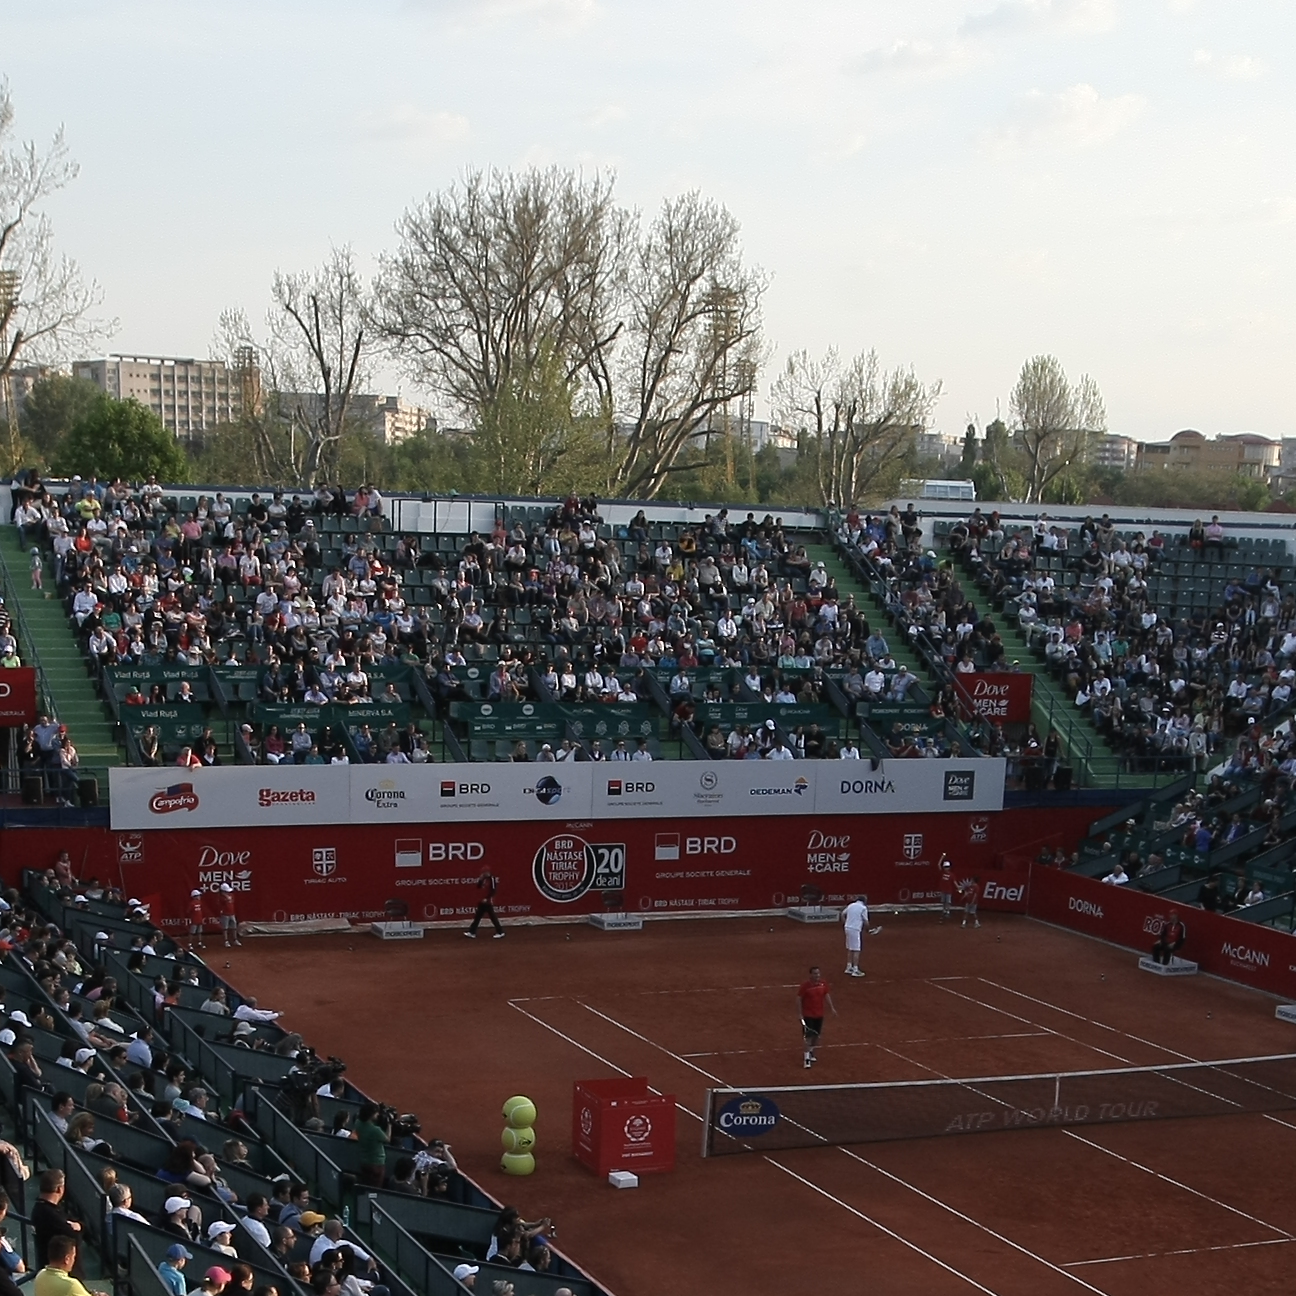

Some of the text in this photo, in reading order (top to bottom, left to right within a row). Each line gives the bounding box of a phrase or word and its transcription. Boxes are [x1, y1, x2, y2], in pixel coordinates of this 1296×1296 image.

[973, 679, 1009, 696] Dove
[973, 698, 997, 708] MEN
[459, 783, 490, 794] BRD
[625, 782, 655, 793] BRD
[840, 780, 895, 794] DORNA
[258, 788, 315, 807] gazeta
[365, 788, 406, 801] Corona
[554, 840, 574, 850] BRD
[686, 836, 736, 854] BRD
[807, 830, 850, 850] Dove
[120, 852, 142, 861] ATP
[198, 846, 251, 867] Dove
[429, 842, 485, 861] BRD
[597, 848, 623, 874] 20
[807, 854, 836, 863] MEN
[552, 862, 578, 870] TIRIAC
[808, 862, 849, 873] +CARE
[199, 871, 234, 882] MEN
[549, 872, 580, 880] TROPHY
[686, 870, 714, 878] SOCIETE
[200, 880, 251, 893] +CRE
[395, 878, 460, 887] GROUPE SOCIETE
[983, 882, 1024, 901] Enel
[1069, 897, 1104, 919] DORNA
[1221, 942, 1270, 967] McCANN
[720, 1112, 776, 1127] Corona
[945, 1101, 1160, 1132] ATP WORLD TOUR
